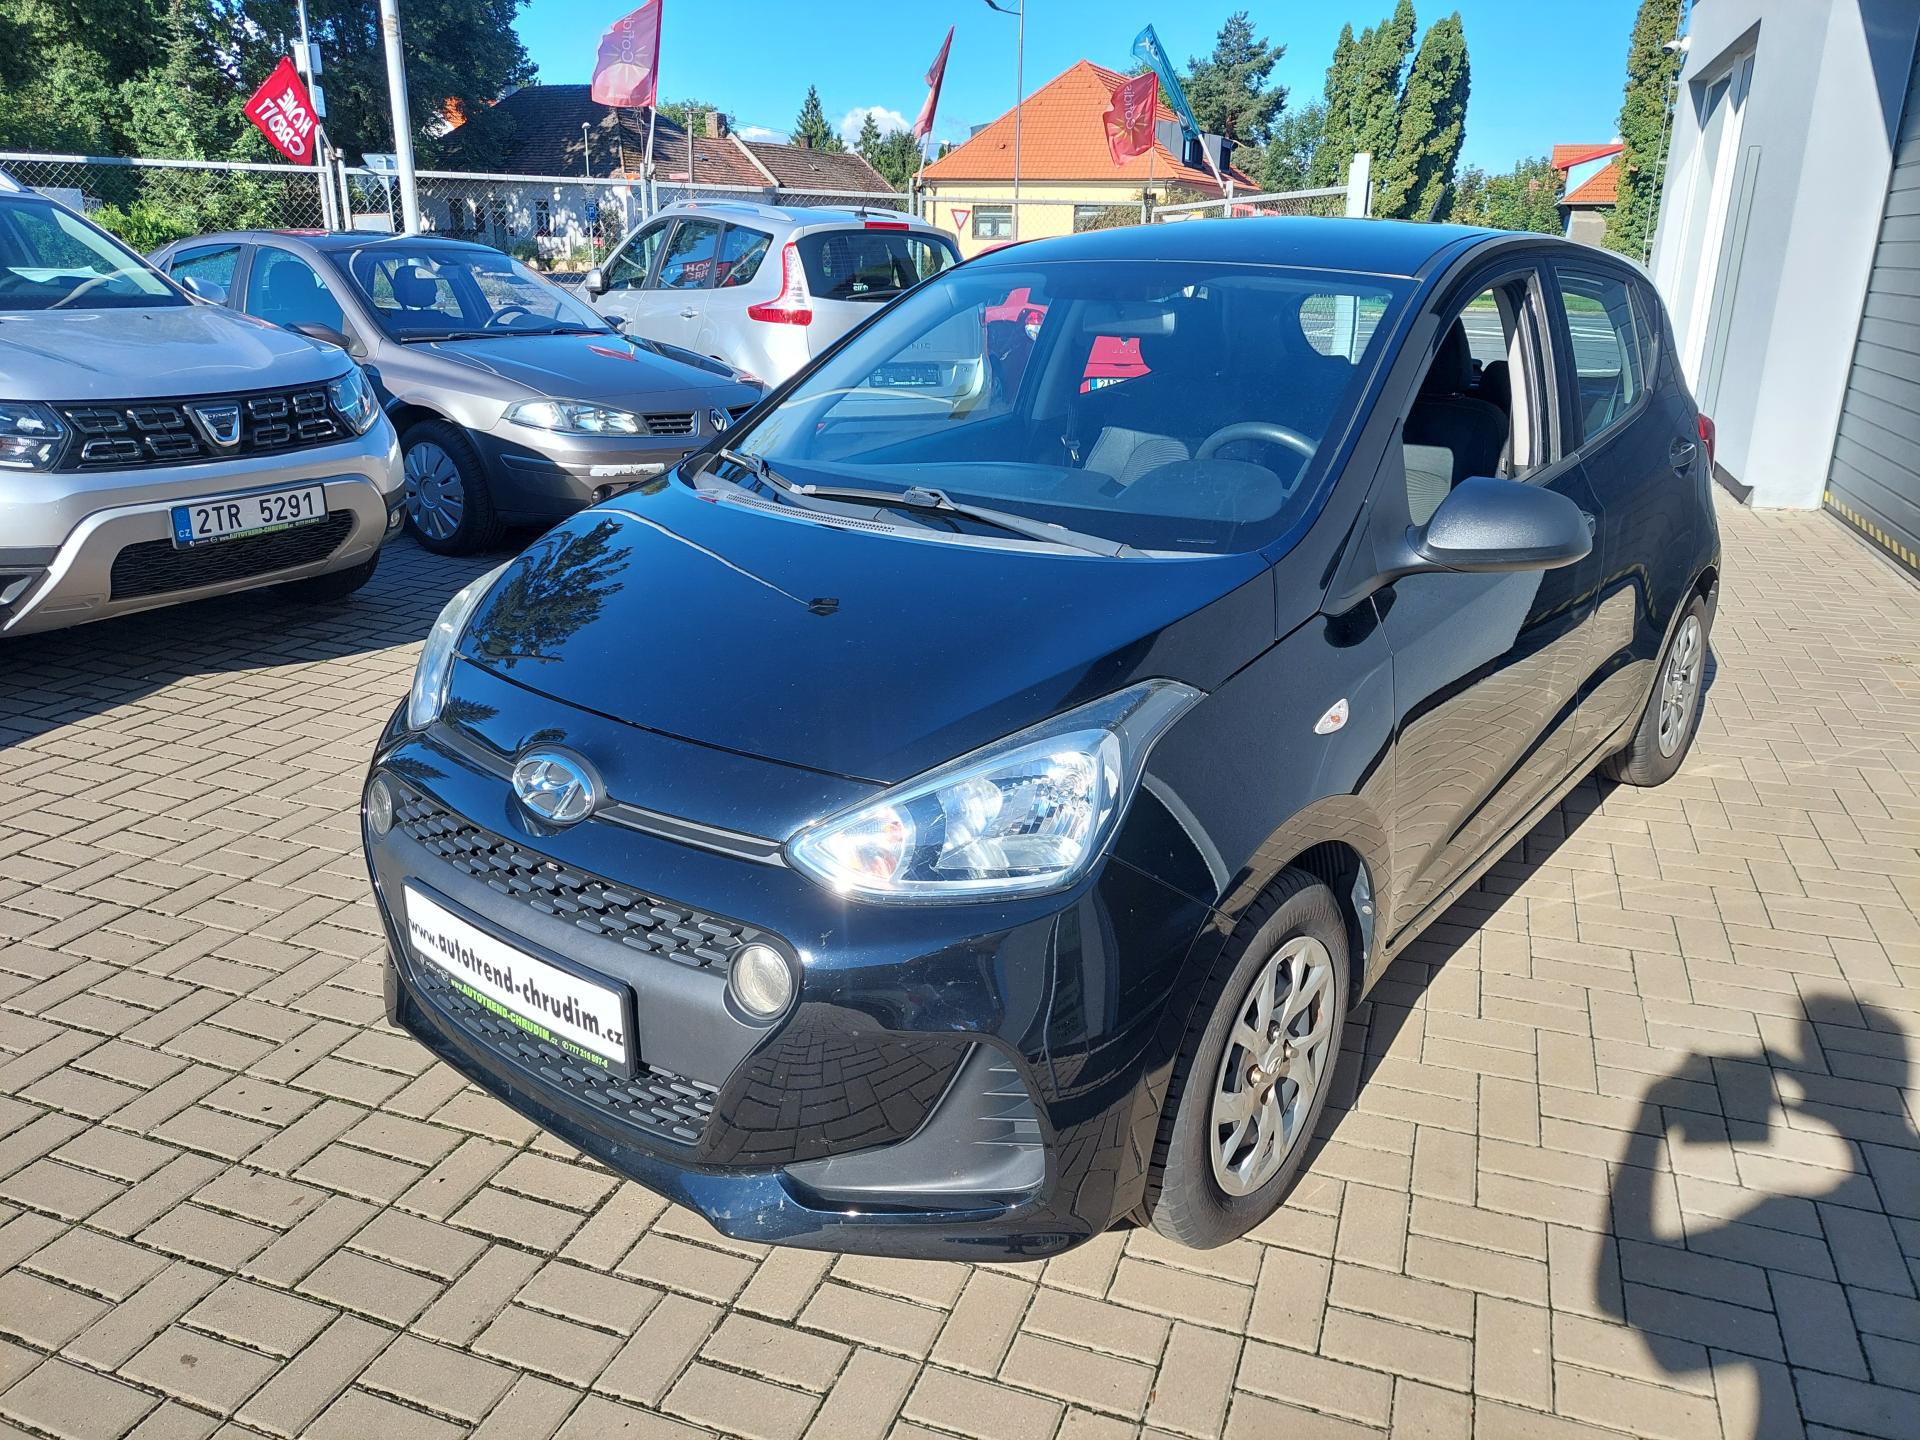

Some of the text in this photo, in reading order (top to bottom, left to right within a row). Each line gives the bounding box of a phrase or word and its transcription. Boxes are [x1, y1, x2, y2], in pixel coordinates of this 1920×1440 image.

[178, 528, 191, 538] CZ
[196, 491, 314, 535] 2TR 5291
[408, 917, 624, 1047] www.autotrend-chrudim.cz
